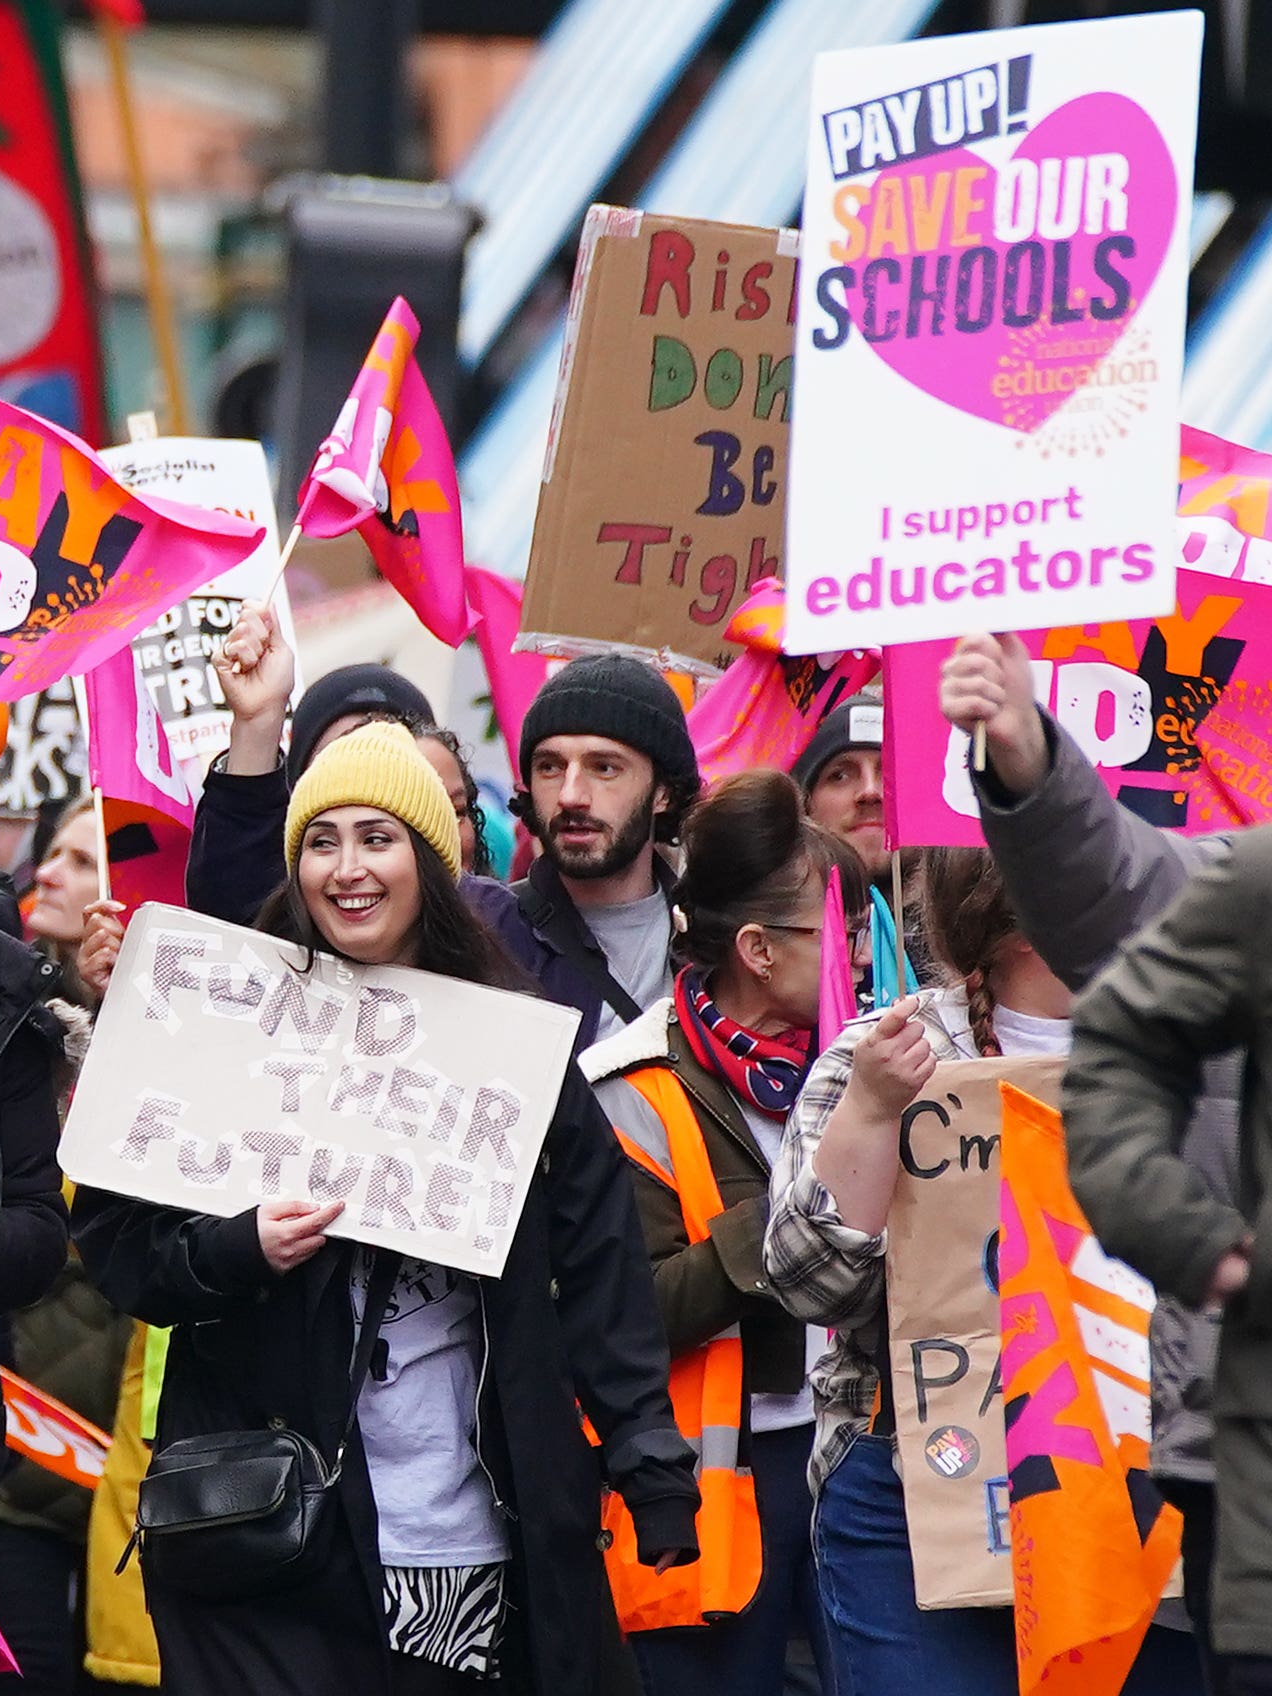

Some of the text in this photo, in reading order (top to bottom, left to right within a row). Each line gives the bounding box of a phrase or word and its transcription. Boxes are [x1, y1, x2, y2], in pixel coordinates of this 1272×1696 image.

[827, 54, 1033, 174] PAY UP!
[829, 152, 1130, 262] SAVE OUR
[640, 230, 798, 327] Ris
[811, 235, 1137, 350] SCHOOLS
[991, 360, 1158, 399] education
[693, 430, 777, 517] Be
[880, 486, 1084, 541] I support
[805, 540, 1157, 616] educators
[145, 934, 417, 1056] FUND
[262, 1060, 522, 1172] THEIR
[119, 1096, 517, 1253] FUTURE!
